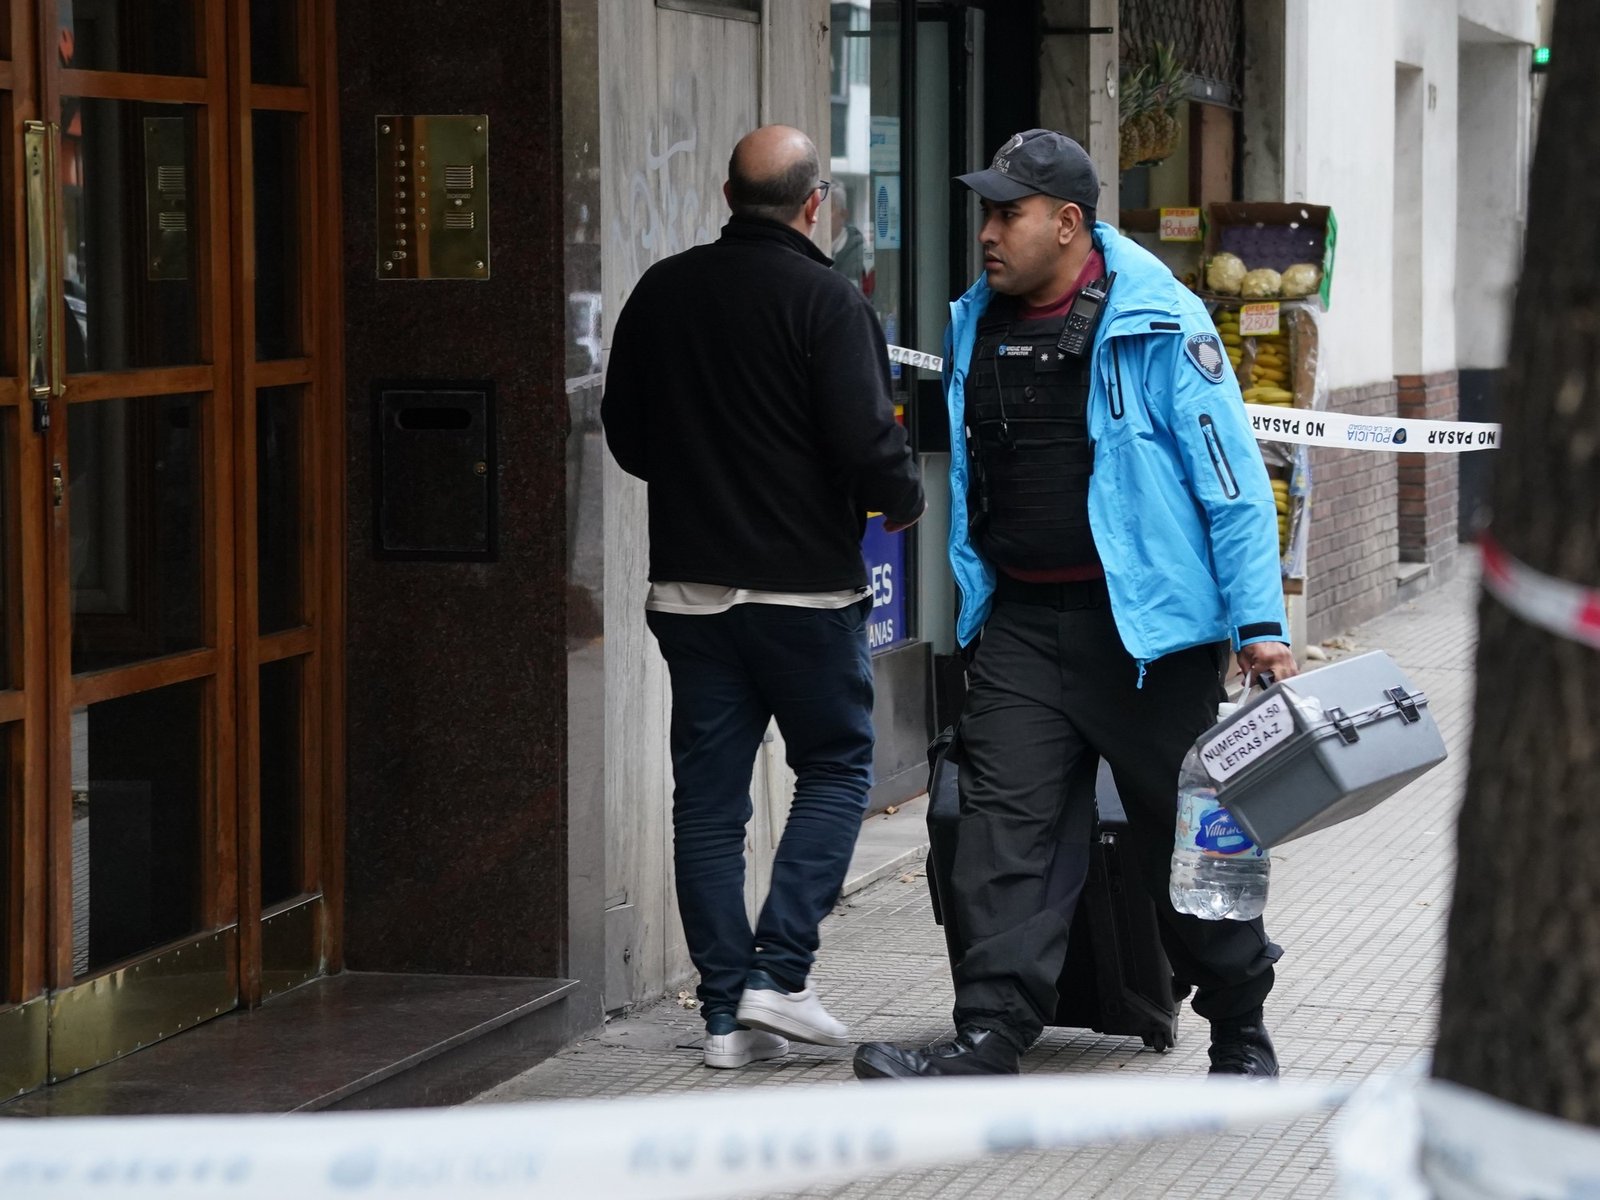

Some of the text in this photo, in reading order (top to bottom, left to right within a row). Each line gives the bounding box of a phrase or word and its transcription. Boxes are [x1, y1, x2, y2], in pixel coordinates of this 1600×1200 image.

[1165, 208, 1196, 217] OFERTA
[1244, 304, 1275, 313] OFERTA
[1252, 416, 1325, 437] NO PASAR
[1348, 424, 1373, 432] CIUDAD
[1347, 430, 1391, 443] POLICIA
[1428, 430, 1496, 445] NO PASAR
[1204, 703, 1280, 762] NUMEROS 1-50
[1219, 722, 1282, 771] LETRAS A-Z
[1205, 823, 1226, 838] Villa
